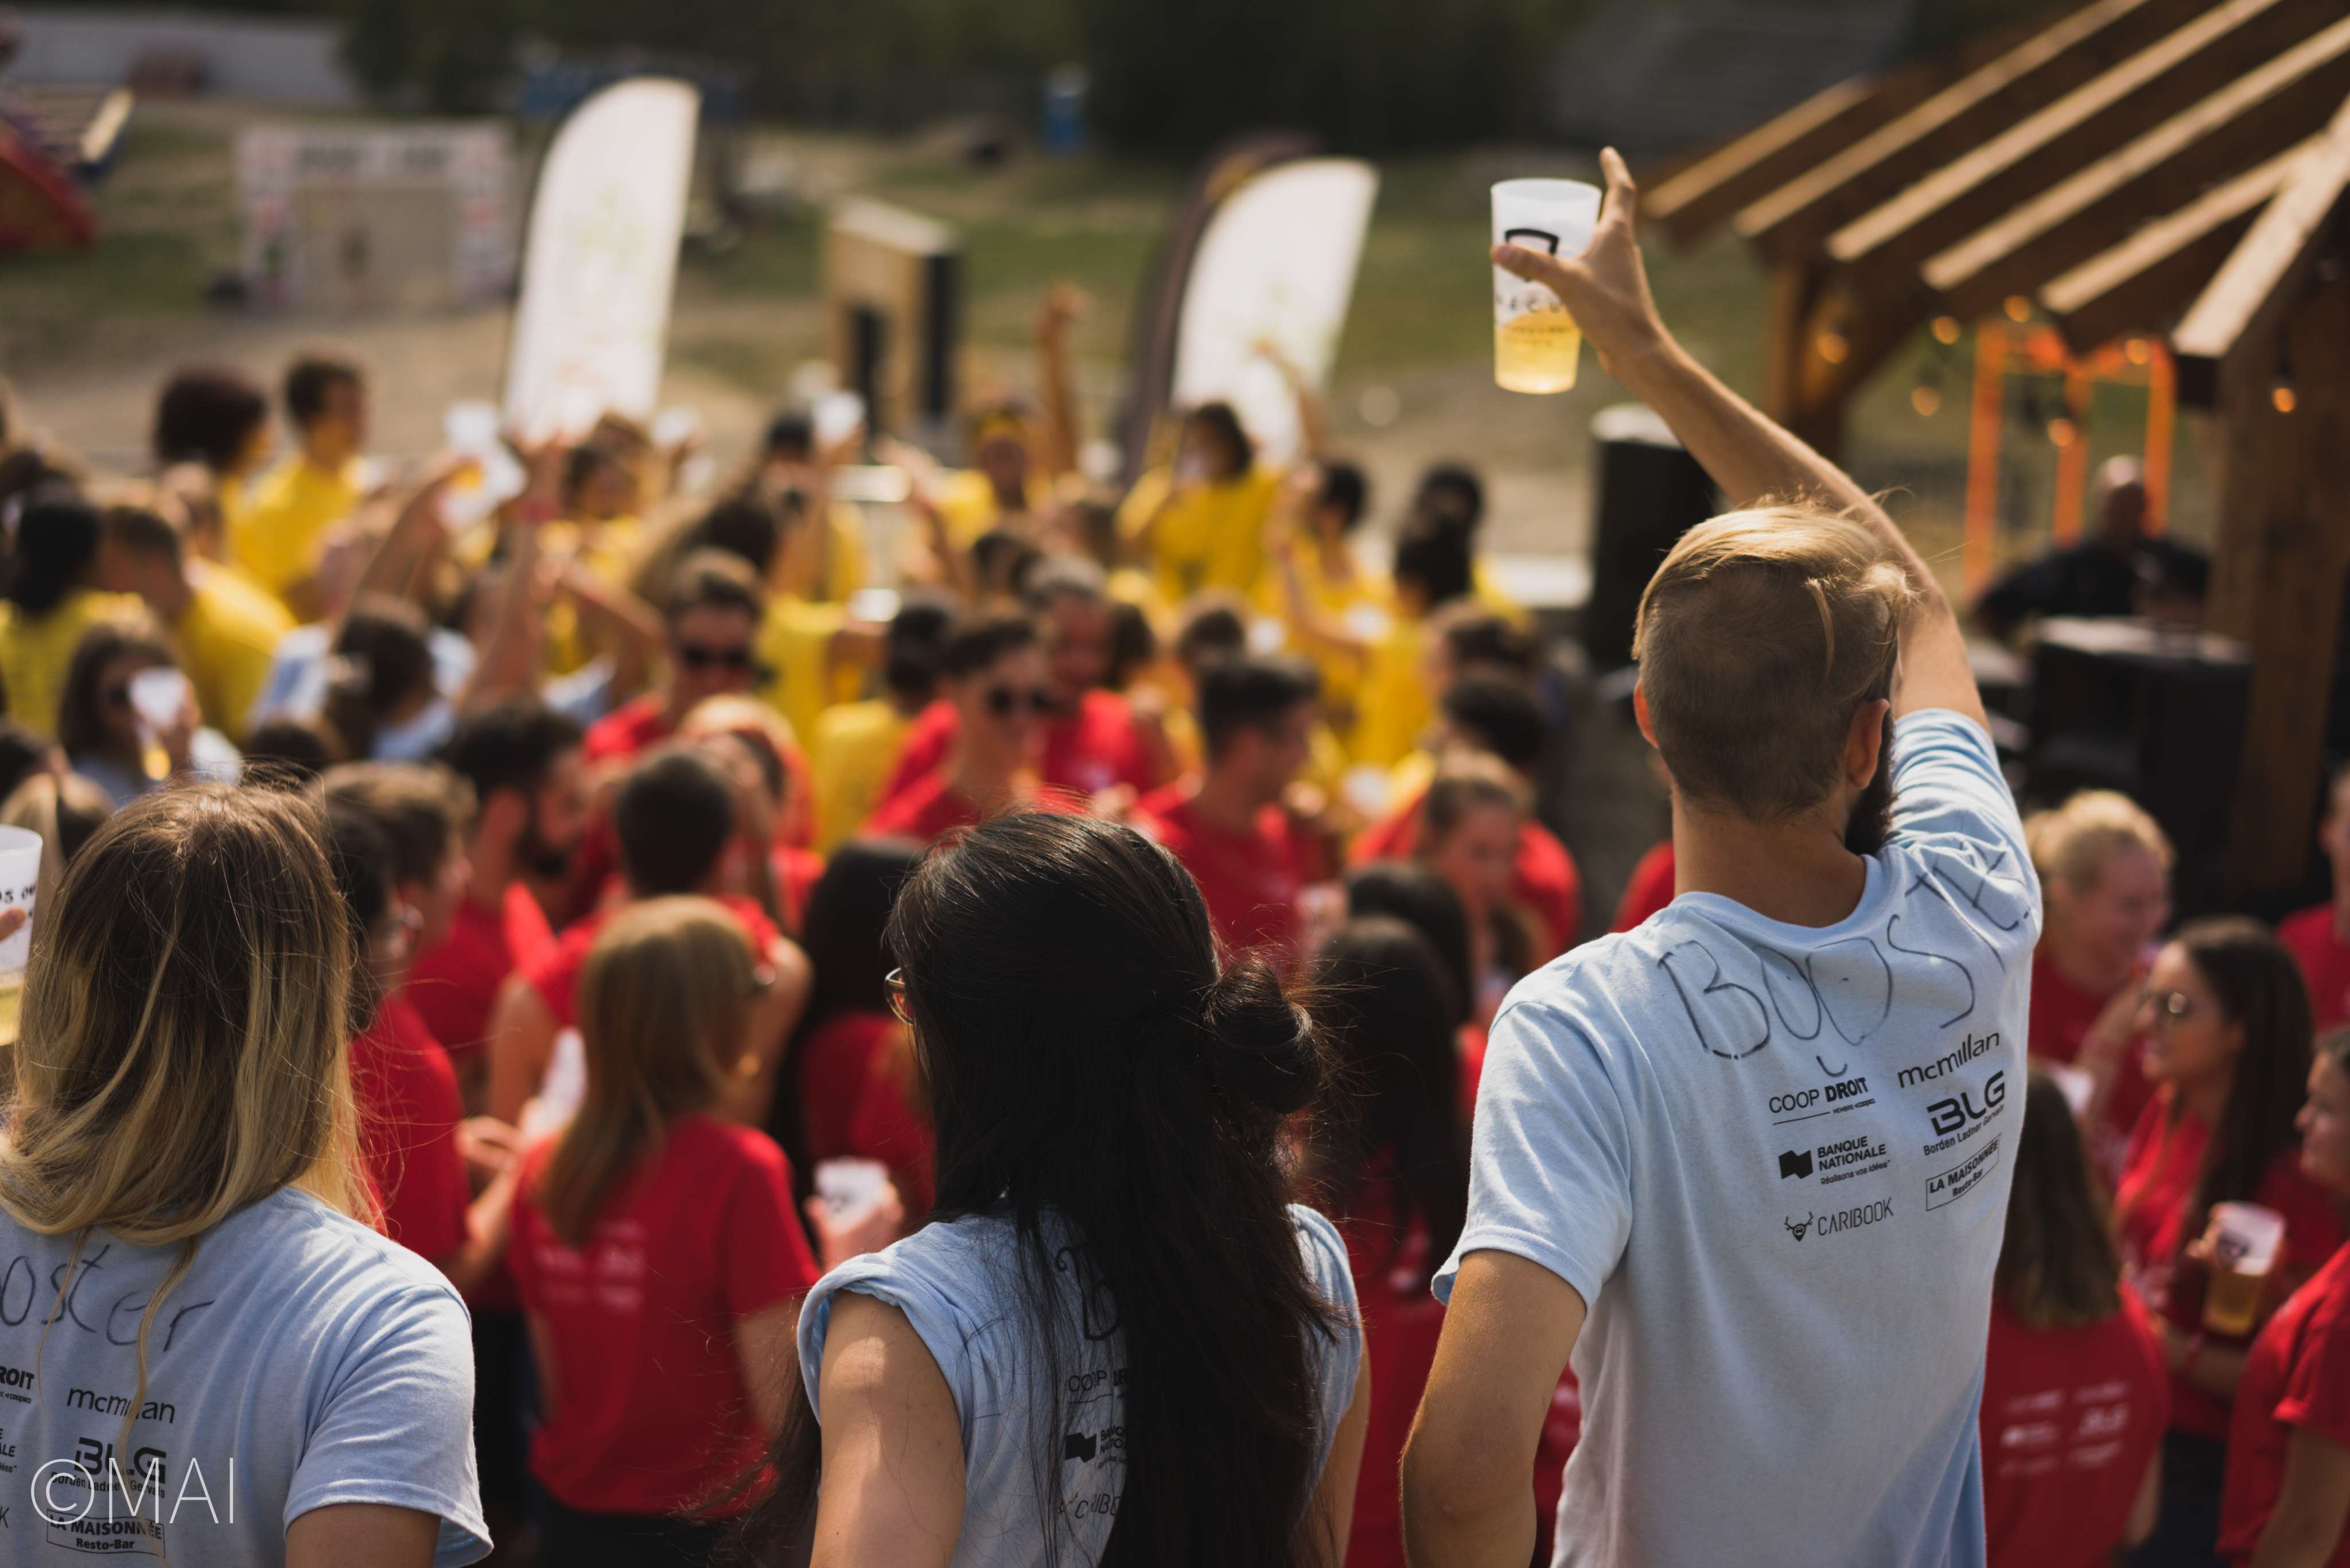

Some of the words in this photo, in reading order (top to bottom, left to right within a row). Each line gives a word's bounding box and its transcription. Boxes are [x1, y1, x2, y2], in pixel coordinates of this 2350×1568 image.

[1897, 1032, 1999, 1088] mcmillan
[1769, 1089, 1820, 1114] COOP
[1824, 1077, 1869, 1103] DROIT
[1926, 1069, 2006, 1137] BLG
[1923, 1137, 1956, 1156] Borden
[1957, 1122, 1982, 1143] Ladner
[1983, 1104, 2004, 1126] Gervais
[1818, 1135, 1869, 1158] BANQUE
[1819, 1143, 1887, 1171] NATIONALE
[1820, 1172, 1854, 1186] Réalisons
[1855, 1166, 1867, 1176] vos
[1929, 1178, 1946, 1194] LA
[1952, 1168, 1983, 1197] Resto-Bar
[1818, 1197, 1894, 1236] CARIBOOK
[76, 1538, 135, 1550] Resto-Bar
